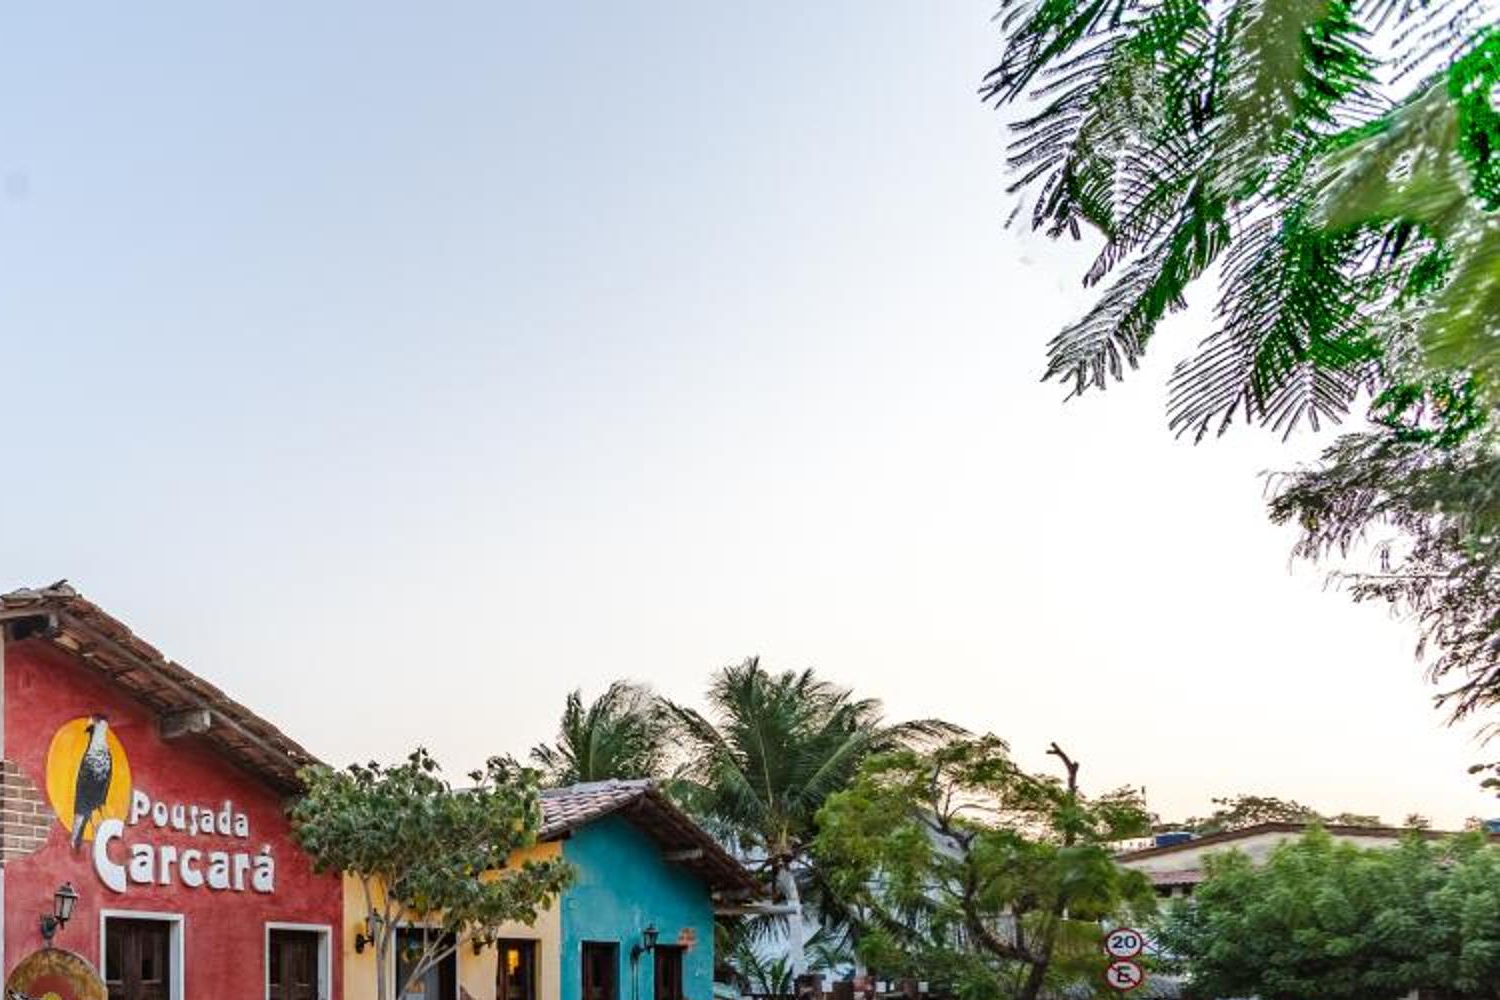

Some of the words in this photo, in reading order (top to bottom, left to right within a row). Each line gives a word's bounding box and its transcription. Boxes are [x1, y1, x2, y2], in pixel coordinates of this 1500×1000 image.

[129, 789, 249, 837] Pousada
[93, 818, 275, 893] Carcará
[1112, 935, 1137, 949] 20
[1117, 965, 1131, 983] E
